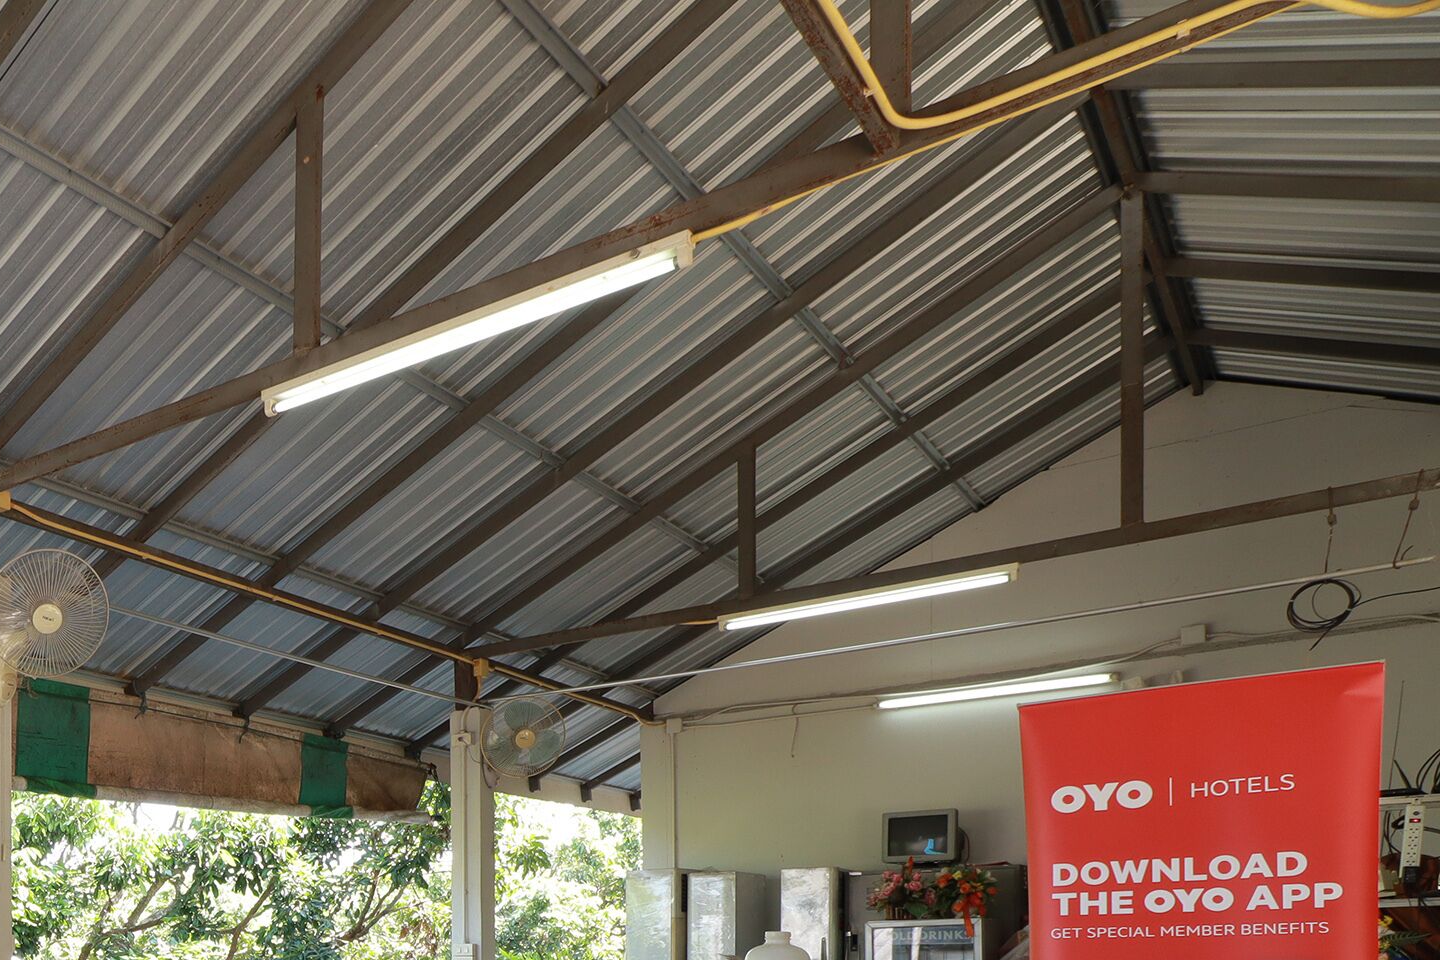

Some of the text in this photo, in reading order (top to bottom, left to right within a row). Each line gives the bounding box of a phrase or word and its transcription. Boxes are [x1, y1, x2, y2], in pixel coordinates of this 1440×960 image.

[1050, 773, 1296, 814] OYO HOTELS
[1052, 851, 1308, 887] DOWNLOAD
[1051, 882, 1343, 916] THE OYO APP
[1050, 921, 1330, 939] GET SPECIAL MEMBER BENEFITS
